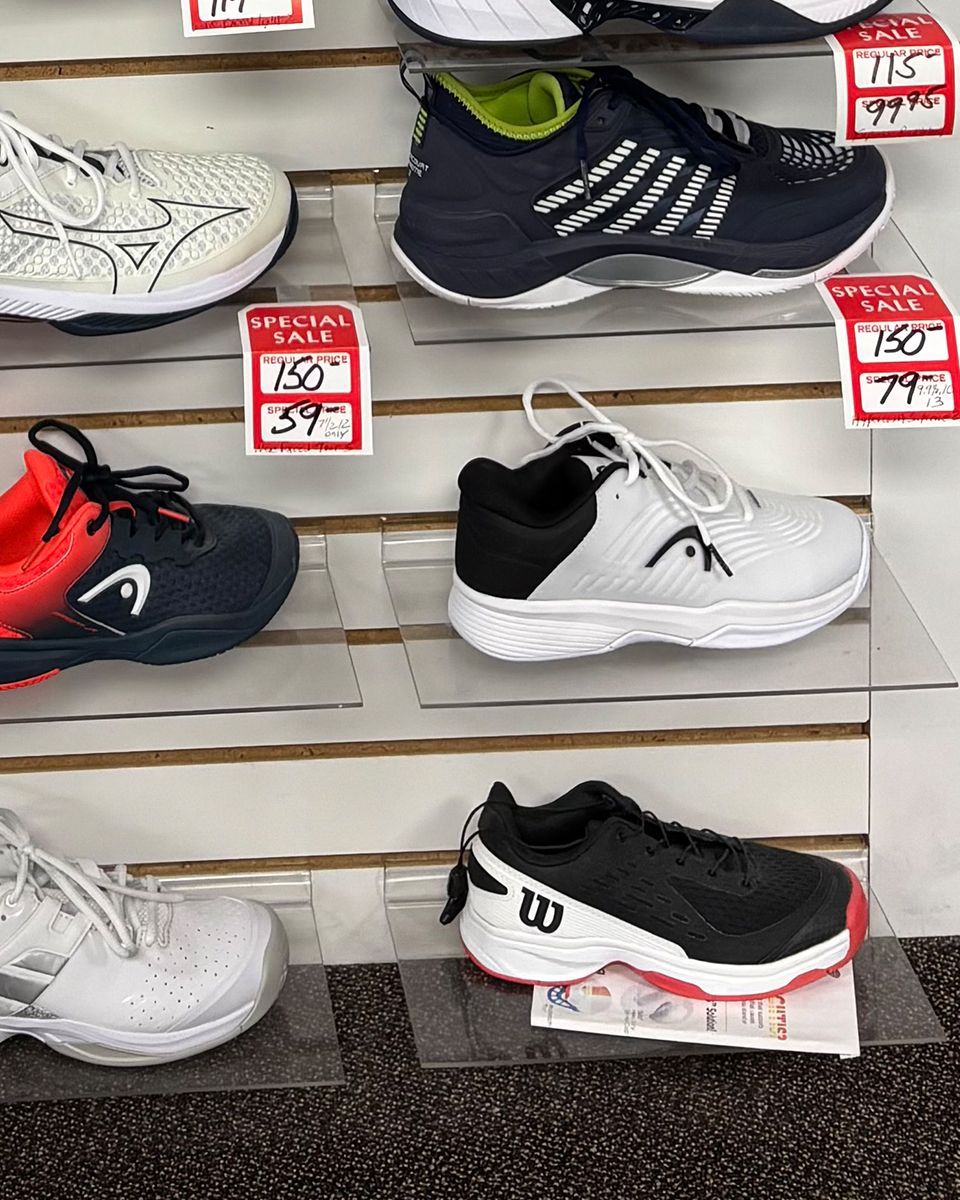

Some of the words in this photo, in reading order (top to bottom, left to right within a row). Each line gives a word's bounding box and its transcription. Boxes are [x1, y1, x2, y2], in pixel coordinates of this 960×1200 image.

[858, 28, 922, 41] SALE
[856, 49, 907, 59] REGULAR
[831, 284, 935, 298] SPECIAL
[860, 299, 924, 312] SALE
[250, 314, 351, 329] SPECIAL
[273, 330, 333, 344] SALE
[317, 355, 348, 364] PRICE
